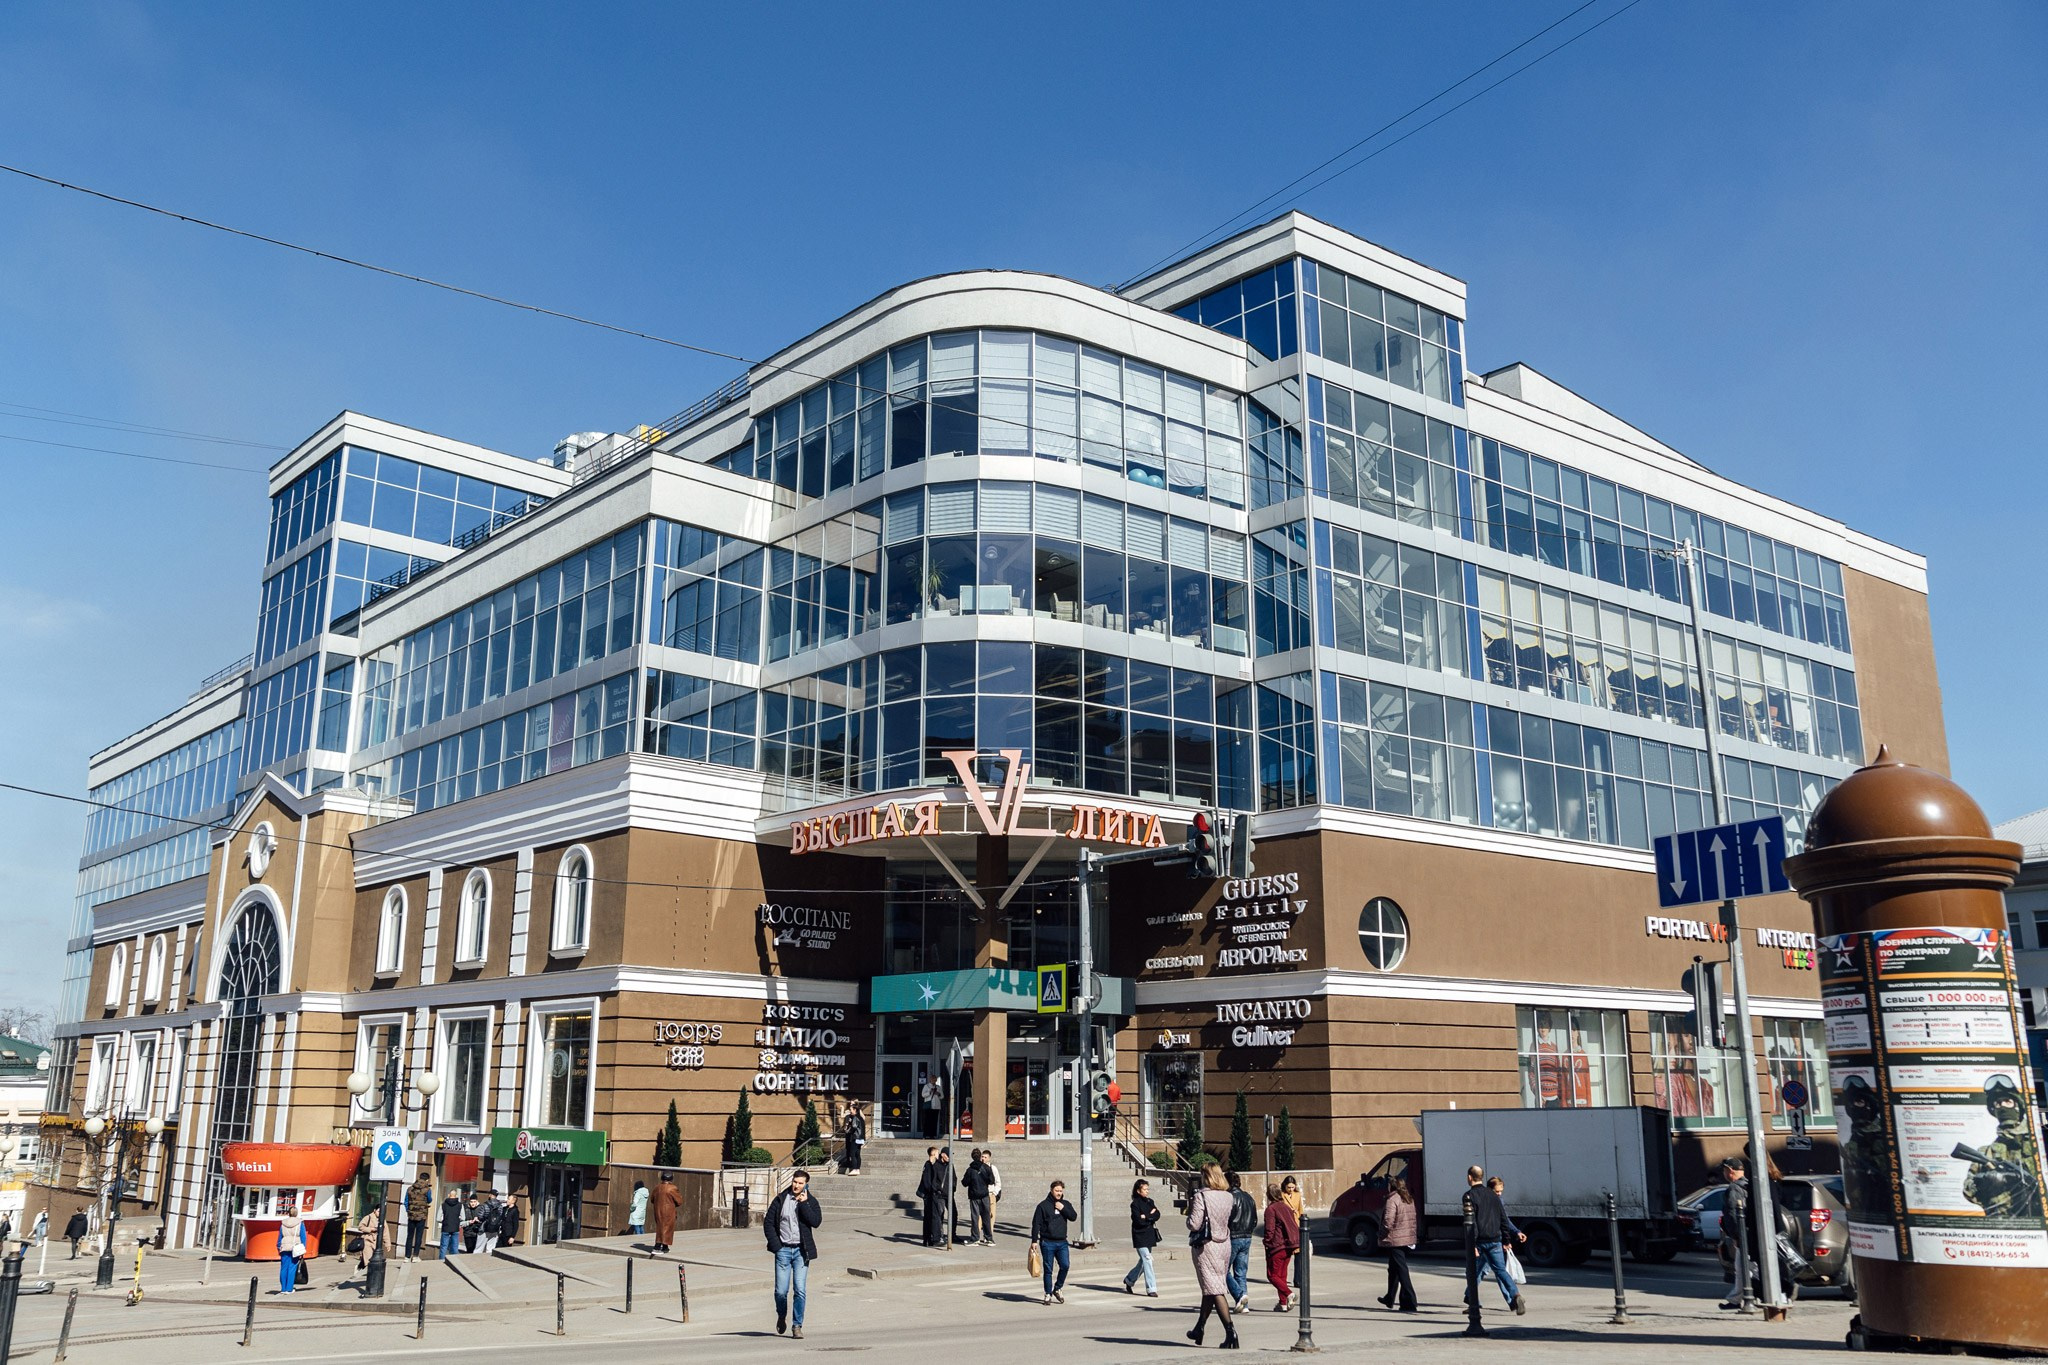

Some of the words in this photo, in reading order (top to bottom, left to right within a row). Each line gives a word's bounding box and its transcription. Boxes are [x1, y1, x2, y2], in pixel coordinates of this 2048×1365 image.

[789, 800, 944, 855] ВЫСШАЯ
[1069, 803, 1170, 848] ЛИГА
[1222, 872, 1300, 901] GUESS
[760, 903, 852, 931] L'OCCITANE
[1214, 897, 1309, 921] Fairly
[800, 929, 811, 938] GO
[811, 930, 837, 941] PILATES
[1232, 924, 1260, 935] UNITED
[1260, 920, 1290, 932] COLORS
[1237, 934, 1248, 944] OF
[1248, 930, 1287, 943] BENETTON
[1646, 916, 1711, 941] PORTAL
[806, 939, 831, 950] STUDIO
[1878, 938, 1924, 947] ВОЕННАЯ
[1924, 937, 1966, 946] СЛУЖБА
[1879, 949, 1894, 957] ПО
[1895, 947, 1951, 957] КОНТРАКТУ
[1844, 997, 1862, 1008] руб.
[1885, 996, 1925, 1004] свыше
[1928, 993, 1933, 1002] 1
[1937, 993, 1962, 1002] 000
[1965, 993, 1986, 1002] 000
[765, 1003, 845, 1023] ROSTIC'S
[1215, 998, 1313, 1023] INCANTO
[656, 1021, 722, 1044] loops
[765, 1025, 837, 1049] ПАТИО
[1231, 1024, 1296, 1048] Gulliver
[754, 1072, 813, 1091] COFFEE
[816, 1073, 849, 1091] LIKE
[382, 1130, 402, 1138] ЗОНА
[518, 1136, 528, 1150] 24
[236, 1161, 273, 1173] Meinl
[1893, 1193, 1903, 1213] 000
